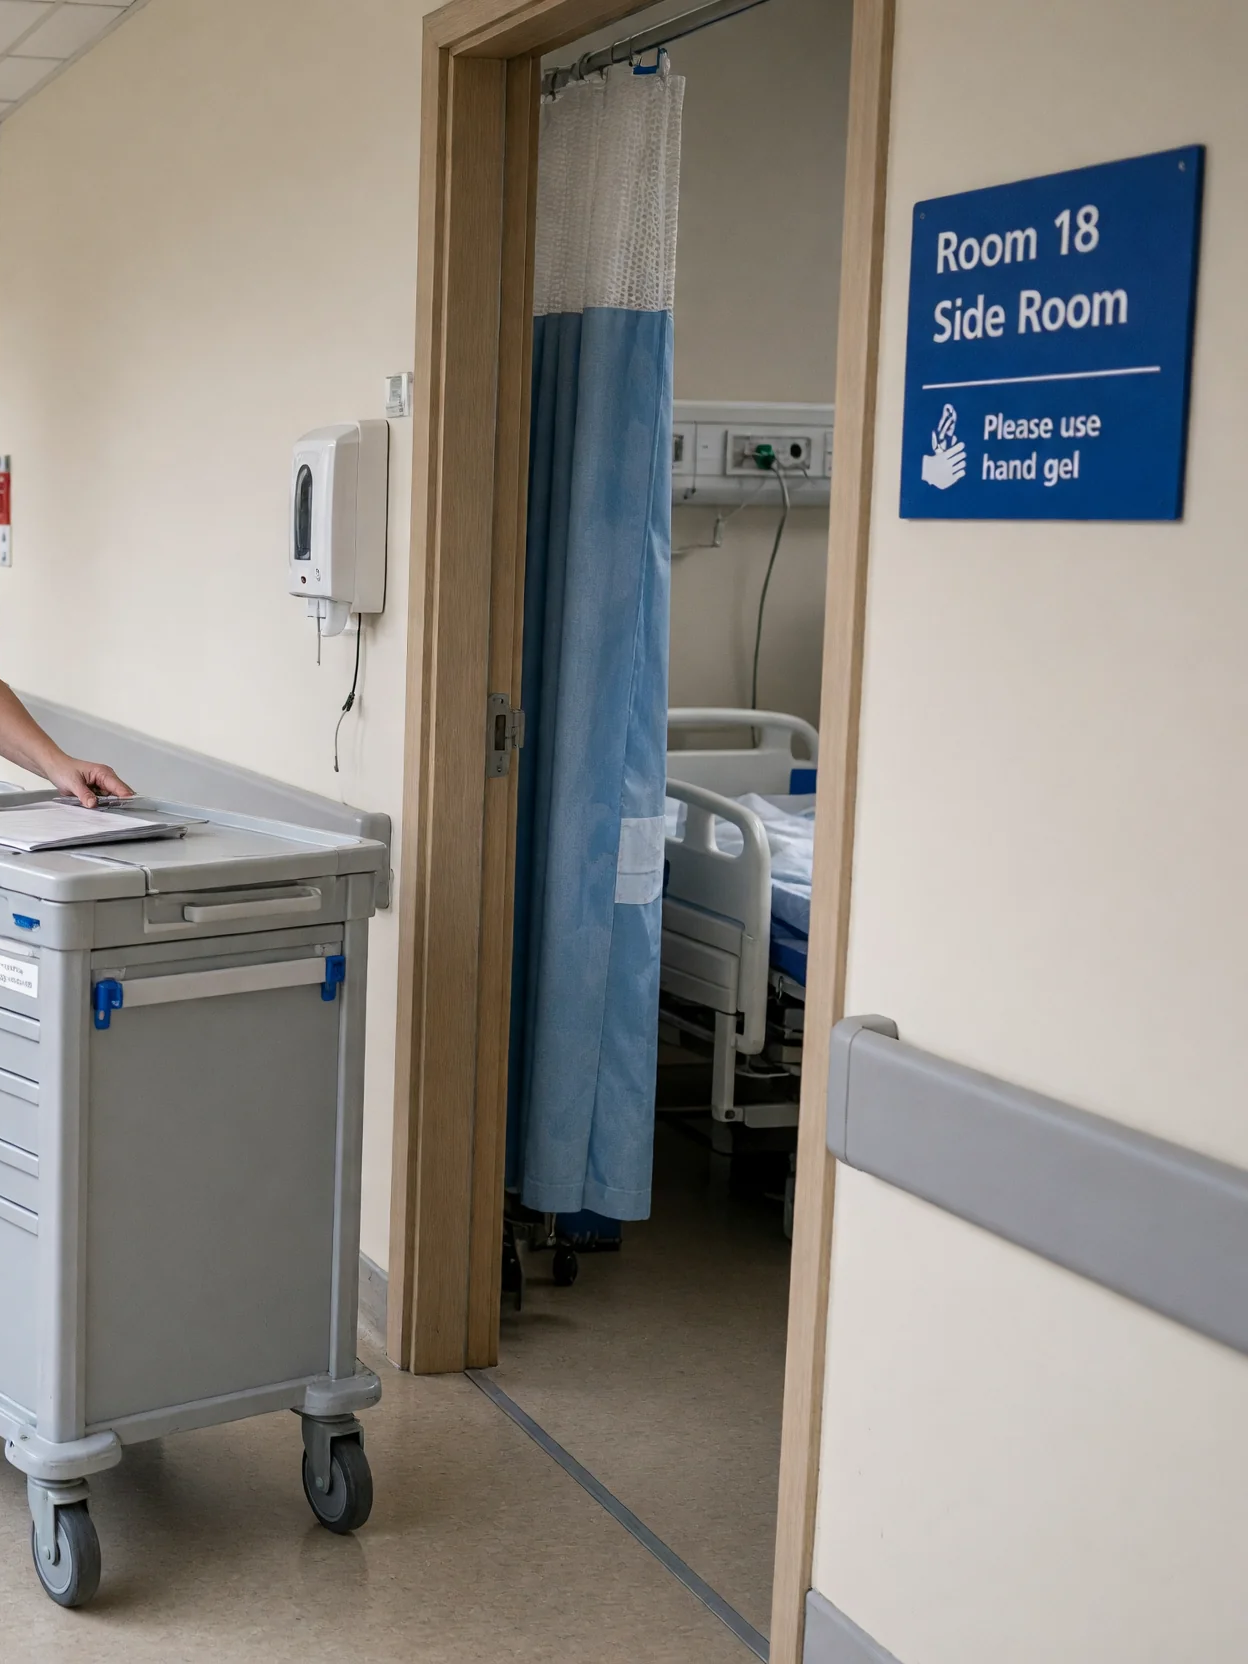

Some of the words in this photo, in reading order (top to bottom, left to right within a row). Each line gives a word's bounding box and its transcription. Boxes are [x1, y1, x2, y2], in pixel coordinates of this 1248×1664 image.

[937, 228, 1037, 274] Room
[1054, 205, 1099, 255] 18
[933, 295, 1005, 343] Side
[1018, 289, 1127, 333] Room
[984, 413, 1053, 440] Please
[1060, 414, 1101, 437] use
[982, 452, 1036, 480] hand
[1043, 451, 1079, 486] gel
